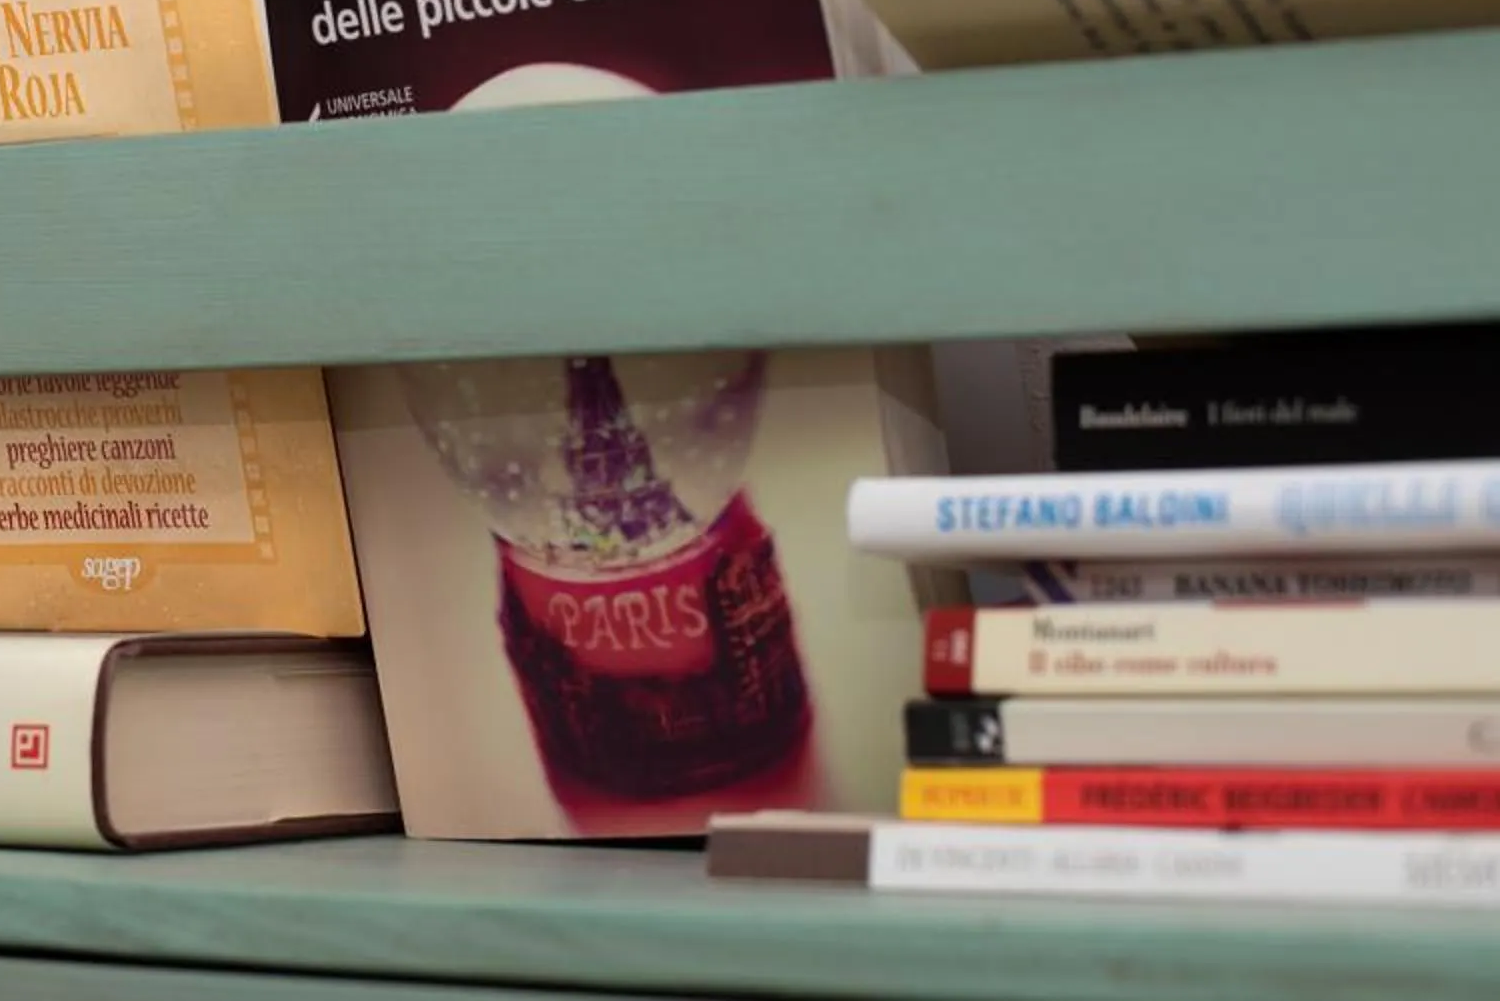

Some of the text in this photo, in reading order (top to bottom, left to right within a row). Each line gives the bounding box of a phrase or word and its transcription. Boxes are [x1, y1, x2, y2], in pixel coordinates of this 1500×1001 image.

[1, 1, 131, 54] NERVIA
[326, 86, 413, 115] UNIVERSALE
[6, 433, 176, 467] preghiere canzoni
[80, 470, 97, 495] di
[100, 468, 196, 495] devozione
[42, 502, 143, 530] medicinali
[145, 502, 208, 529] ricette
[936, 494, 1082, 532] STEFANO
[1093, 490, 1229, 530] BALDINI
[549, 585, 708, 651] PARIS
